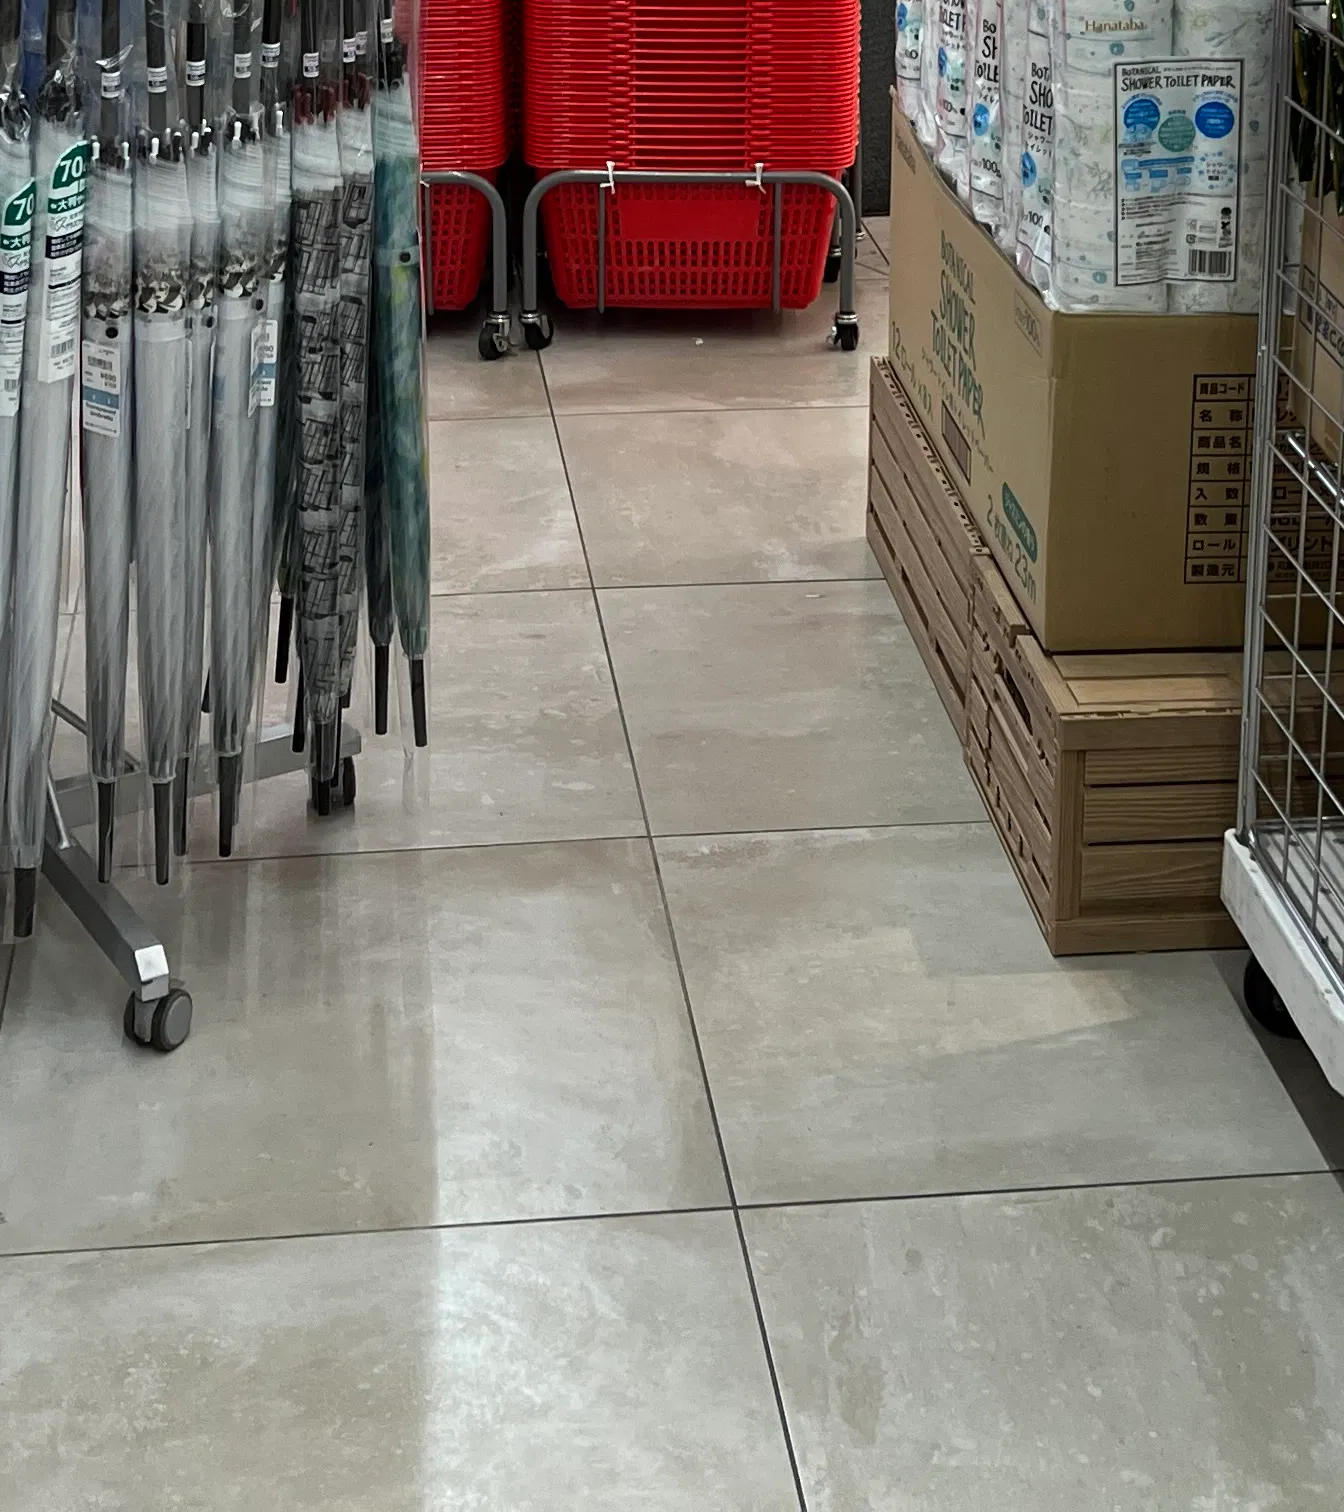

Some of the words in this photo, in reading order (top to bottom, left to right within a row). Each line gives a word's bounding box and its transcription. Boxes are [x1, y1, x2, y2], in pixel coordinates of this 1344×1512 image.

[1122, 66, 1161, 76] BOTANICAL
[1122, 76, 1162, 91] SHOWER
[1201, 75, 1235, 88] PAPER
[1198, 434, 1242, 449] 商品名
